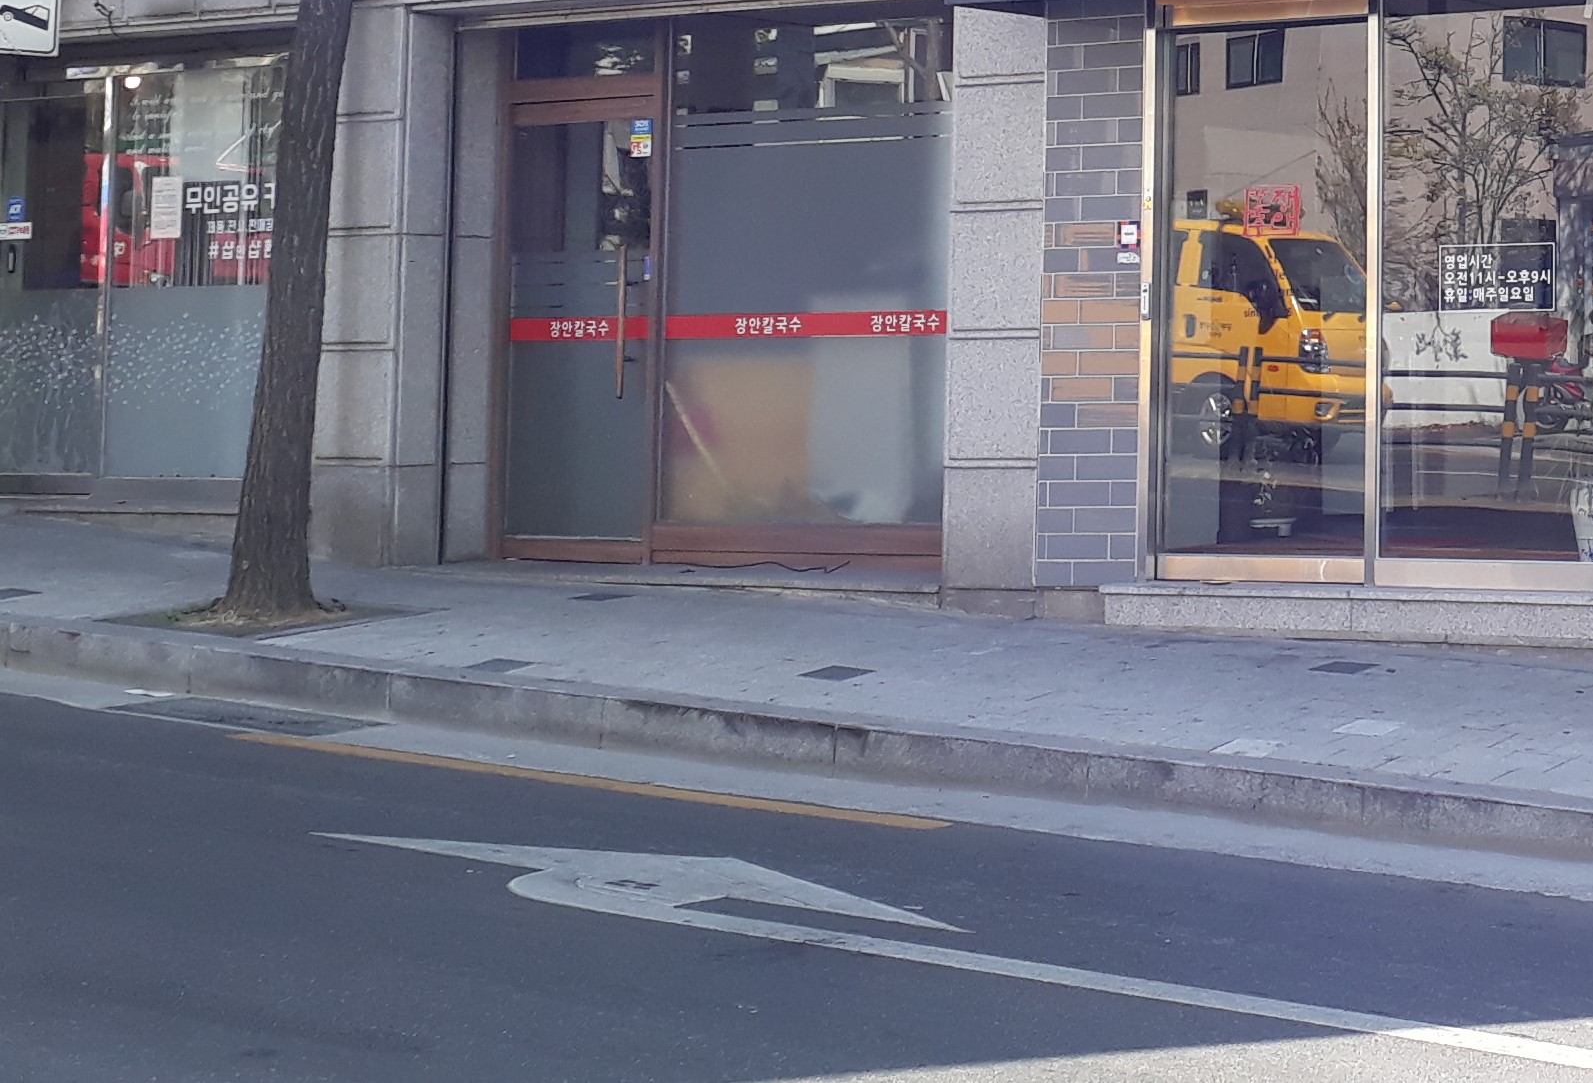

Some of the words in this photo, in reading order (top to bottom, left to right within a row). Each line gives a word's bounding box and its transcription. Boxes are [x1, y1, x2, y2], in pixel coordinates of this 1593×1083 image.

[1444, 253, 1493, 270] 영업시간
[549, 320, 610, 339] 장안칼국수
[734, 316, 802, 335] 장안칼국수
[870, 314, 941, 333] 장안칼국수
